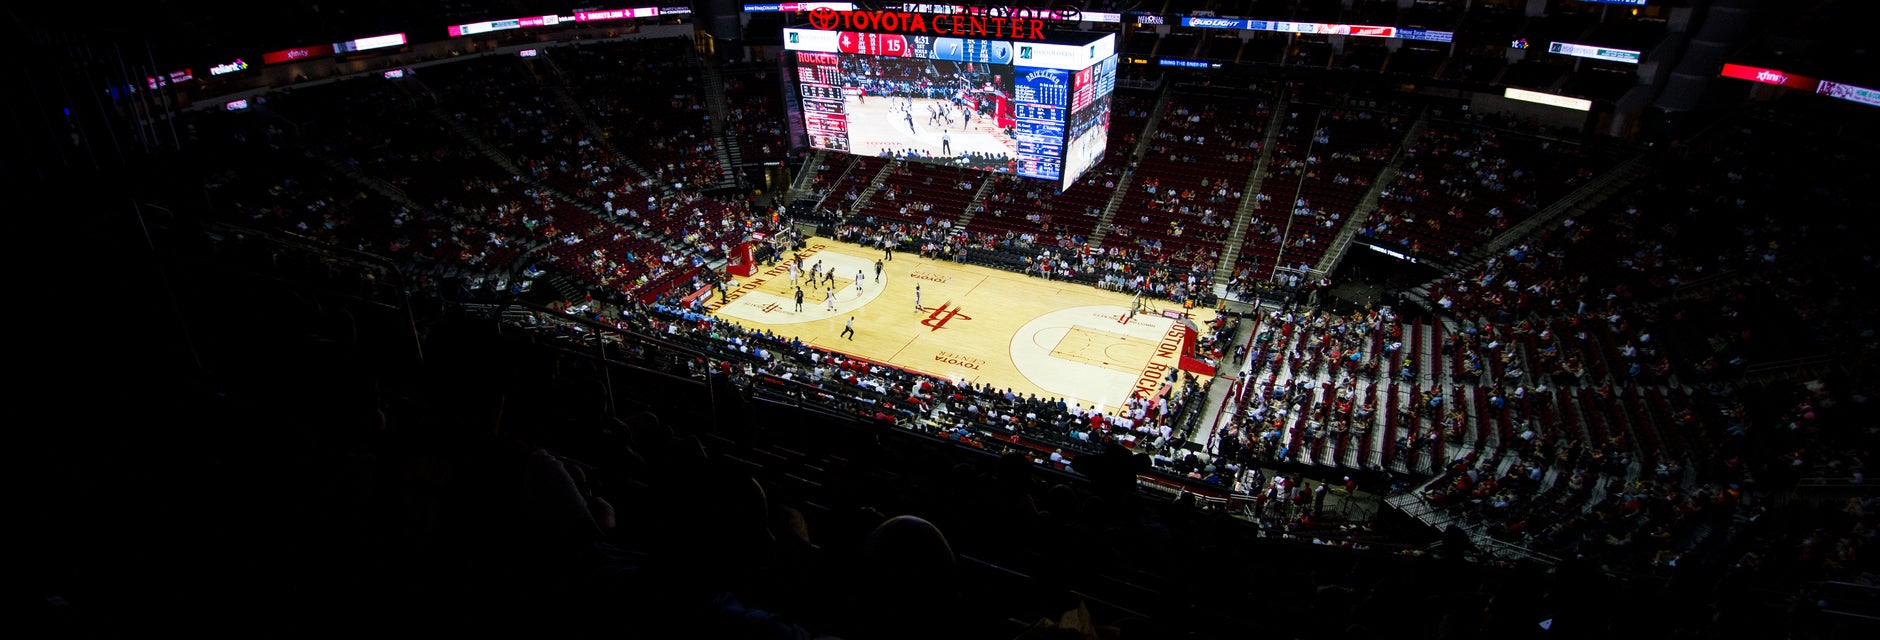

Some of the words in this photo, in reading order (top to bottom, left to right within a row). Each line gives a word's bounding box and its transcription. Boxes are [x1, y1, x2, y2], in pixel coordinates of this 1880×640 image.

[841, 10, 927, 33] TOYOTA
[932, 14, 1046, 40] CENTER
[1193, 17, 1212, 26] BUD
[1212, 18, 1240, 27] LIGHT
[887, 40, 900, 51] 15
[914, 35, 929, 45] 4:31
[287, 48, 309, 60] xfinity
[949, 44, 957, 56] 7
[797, 51, 837, 65] ROCKETS
[210, 64, 240, 76] reliant
[1757, 70, 1788, 84] xfinity
[764, 243, 826, 277] ROCETS
[910, 273, 946, 284] TOYOTA
[934, 354, 980, 371] TOYOTA
